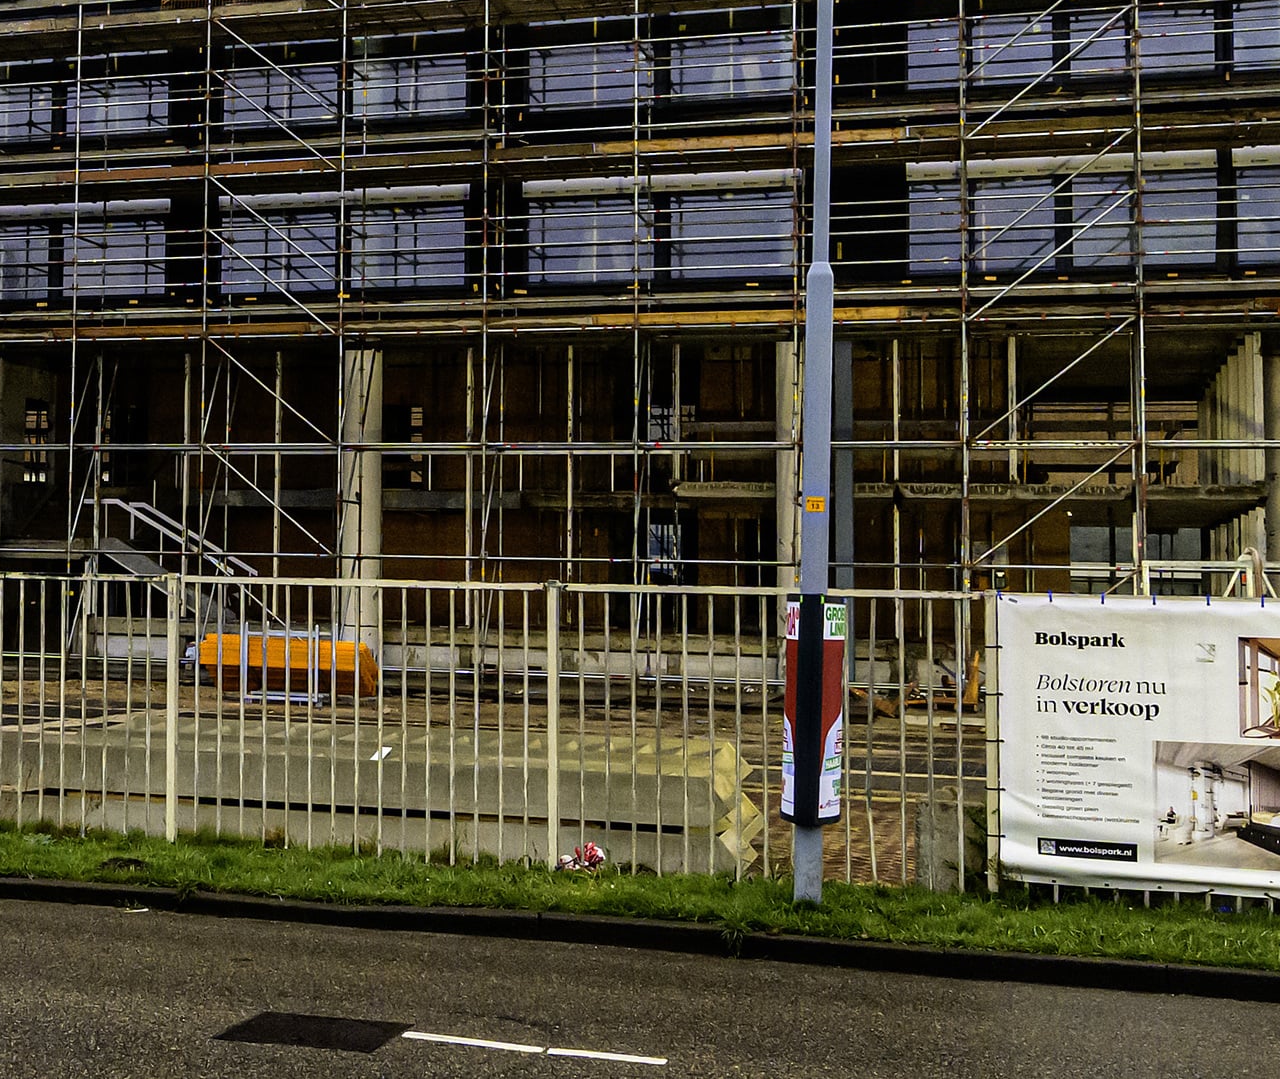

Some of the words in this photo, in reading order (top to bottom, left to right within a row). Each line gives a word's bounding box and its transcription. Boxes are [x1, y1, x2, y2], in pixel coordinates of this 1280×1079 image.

[1035, 631, 1125, 649] Bolspark
[1036, 674, 1131, 693] Bolstoren
[1136, 681, 1166, 694] nu
[1037, 695, 1057, 713] in
[1063, 698, 1160, 721] verkoop
[1059, 846, 1132, 856] www.bolspark.nl
